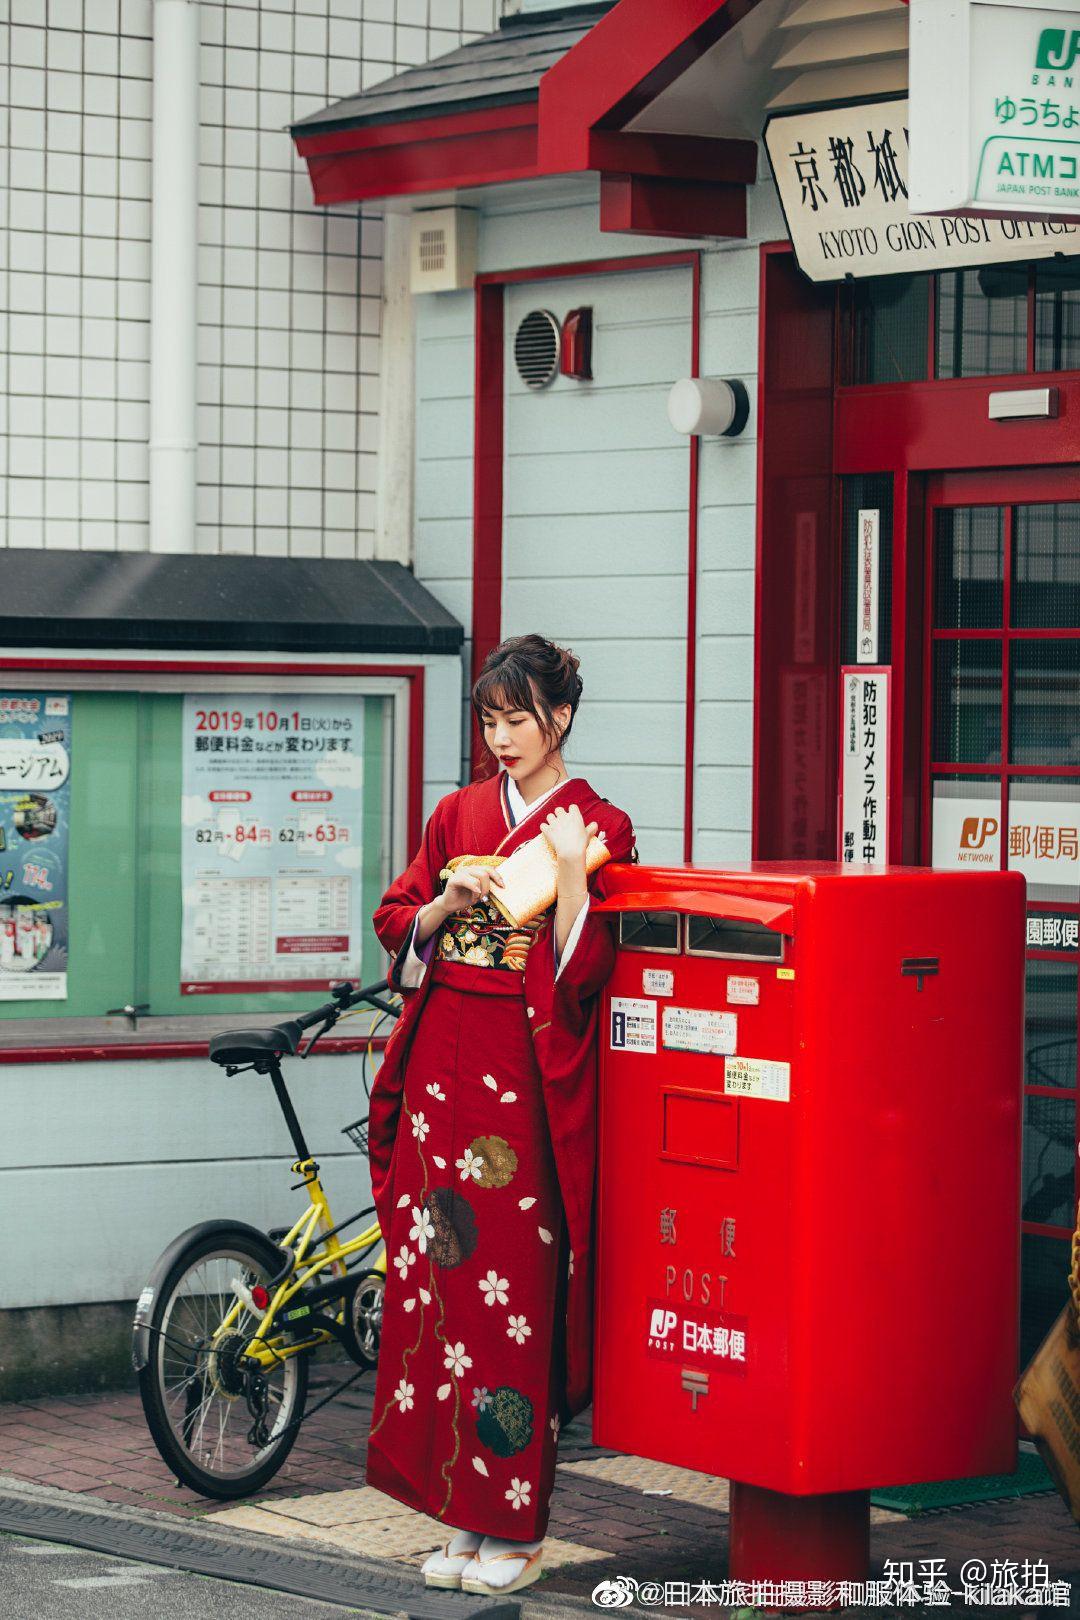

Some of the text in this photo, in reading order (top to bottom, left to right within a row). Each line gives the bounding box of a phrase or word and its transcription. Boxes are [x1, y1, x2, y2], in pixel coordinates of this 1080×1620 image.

[995, 96, 1080, 129] ゆうちょ
[789, 127, 908, 211] 京都祇
[996, 183, 1025, 194] JAPAN
[1029, 185, 1051, 196] POST
[818, 226, 878, 259] KYOTO
[886, 219, 937, 252] GION
[941, 216, 991, 246] POST
[862, 680, 877, 863] 防犯カメラ作動中
[960, 817, 998, 849] JP
[1009, 825, 1079, 861] 郵便局
[958, 853, 993, 863] NETWORK
[666, 1265, 728, 1307] POST
[650, 1309, 677, 1338] JP
[648, 1338, 674, 1351] POST
[683, 1320, 745, 1362] 日本郵便
